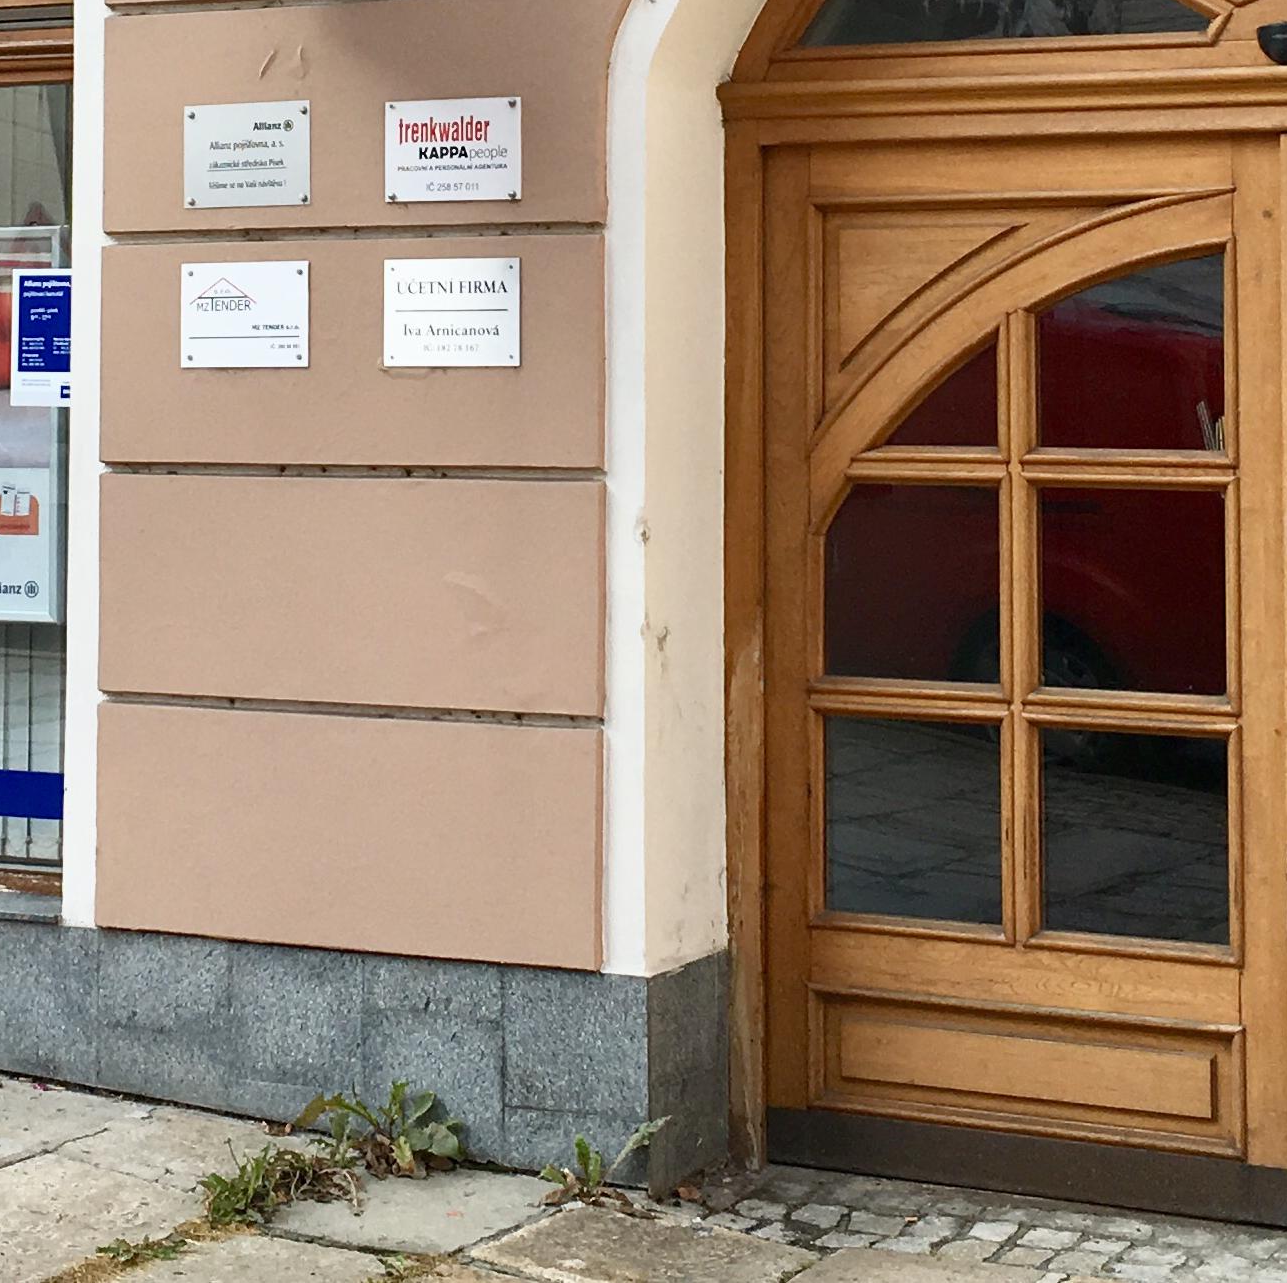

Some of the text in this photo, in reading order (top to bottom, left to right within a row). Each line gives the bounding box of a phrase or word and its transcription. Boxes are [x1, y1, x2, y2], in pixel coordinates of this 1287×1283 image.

[252, 121, 282, 132] Allianz
[398, 115, 491, 145] trenkwalder
[459, 280, 508, 294] FIRMA
[403, 324, 421, 336] Iva
